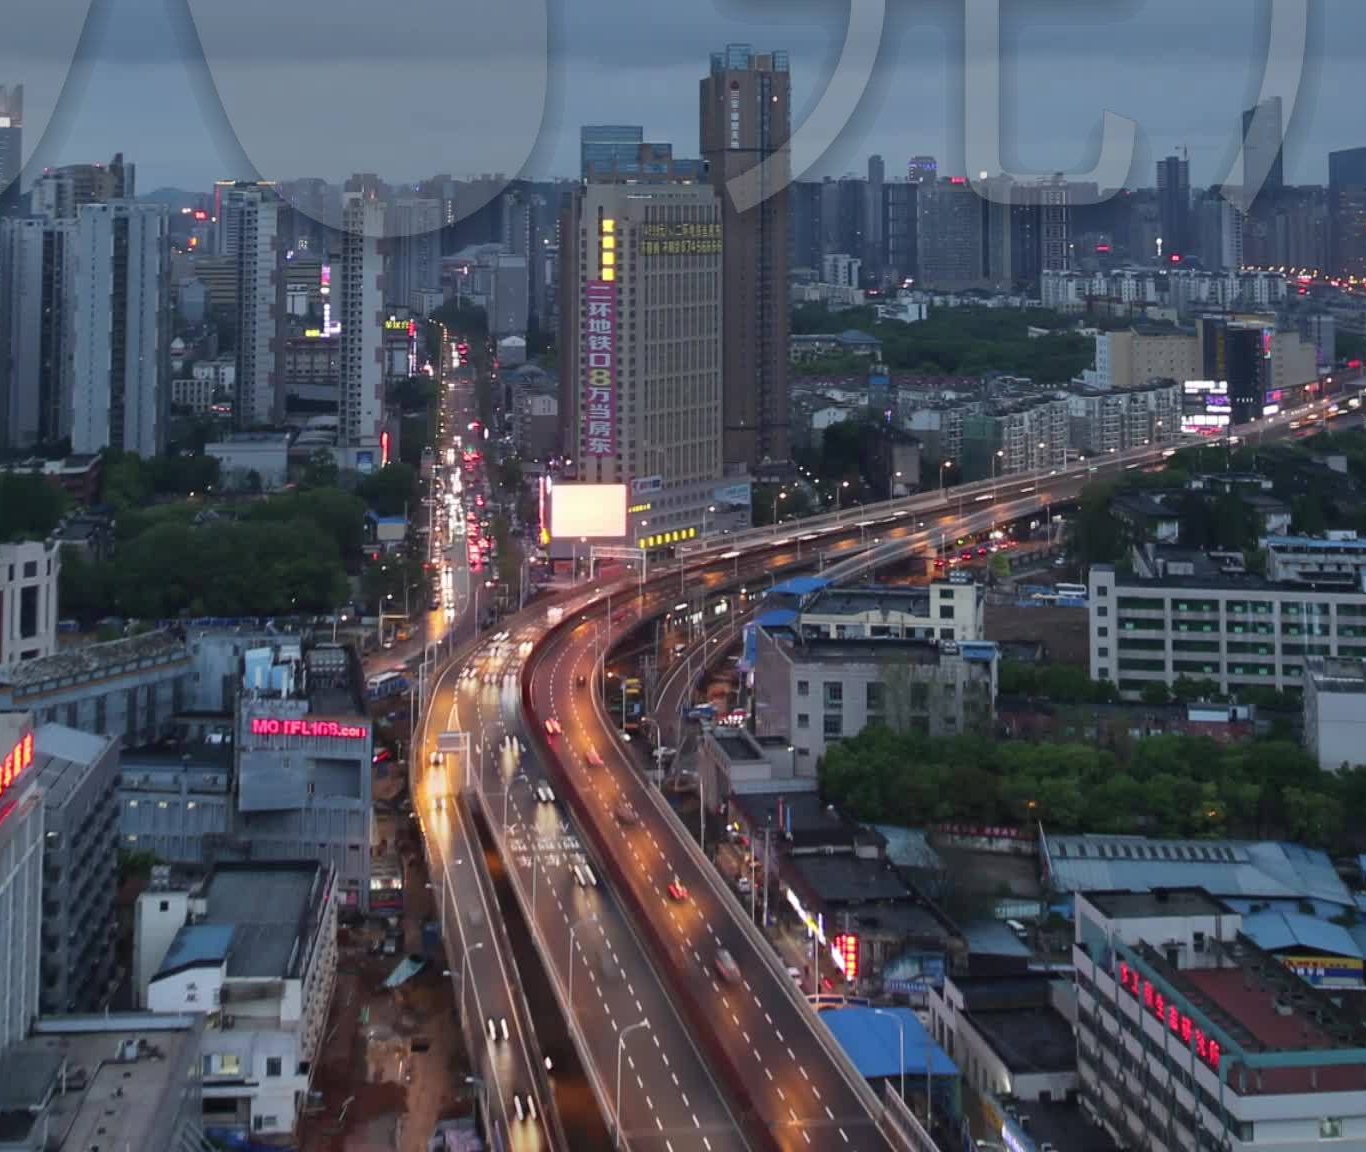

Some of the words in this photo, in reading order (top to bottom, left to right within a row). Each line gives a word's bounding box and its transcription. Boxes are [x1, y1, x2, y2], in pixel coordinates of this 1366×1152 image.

[588, 285, 612, 454] 二环地铁口8万当房东
